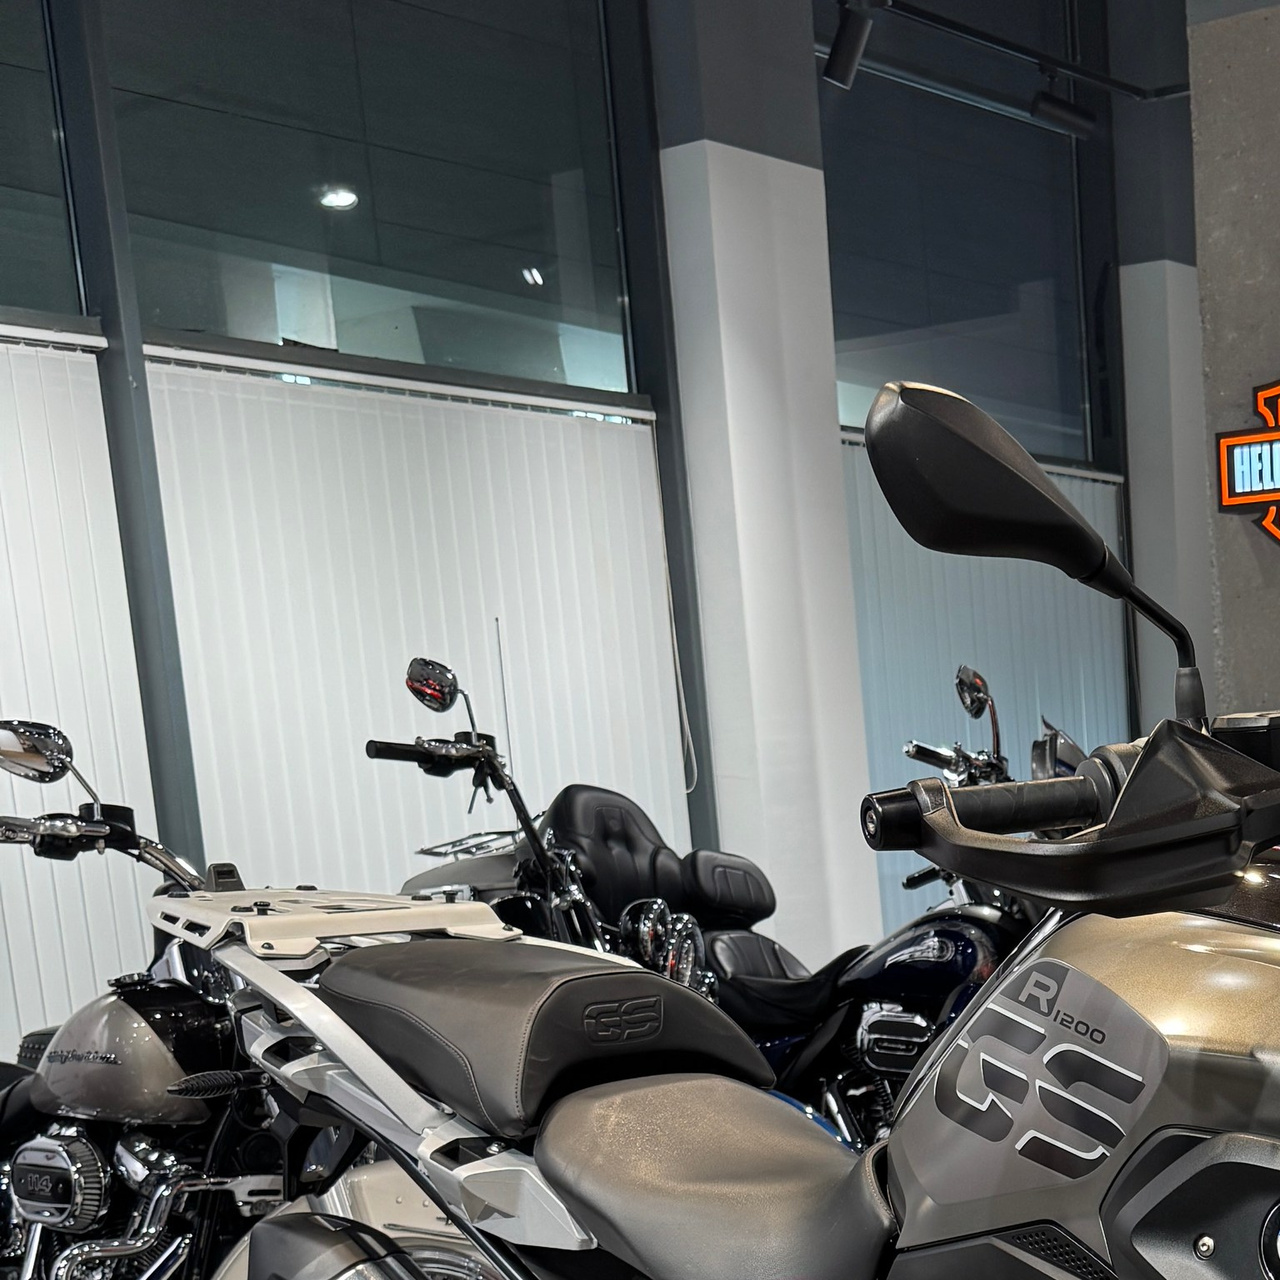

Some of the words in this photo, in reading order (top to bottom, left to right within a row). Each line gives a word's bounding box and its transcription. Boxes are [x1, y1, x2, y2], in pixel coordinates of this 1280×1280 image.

[583, 996, 661, 1042] GS
[1018, 971, 1058, 1015] R
[1053, 1009, 1106, 1045] 1200
[934, 1002, 1146, 1180] GS
[27, 1172, 52, 1193] 114
